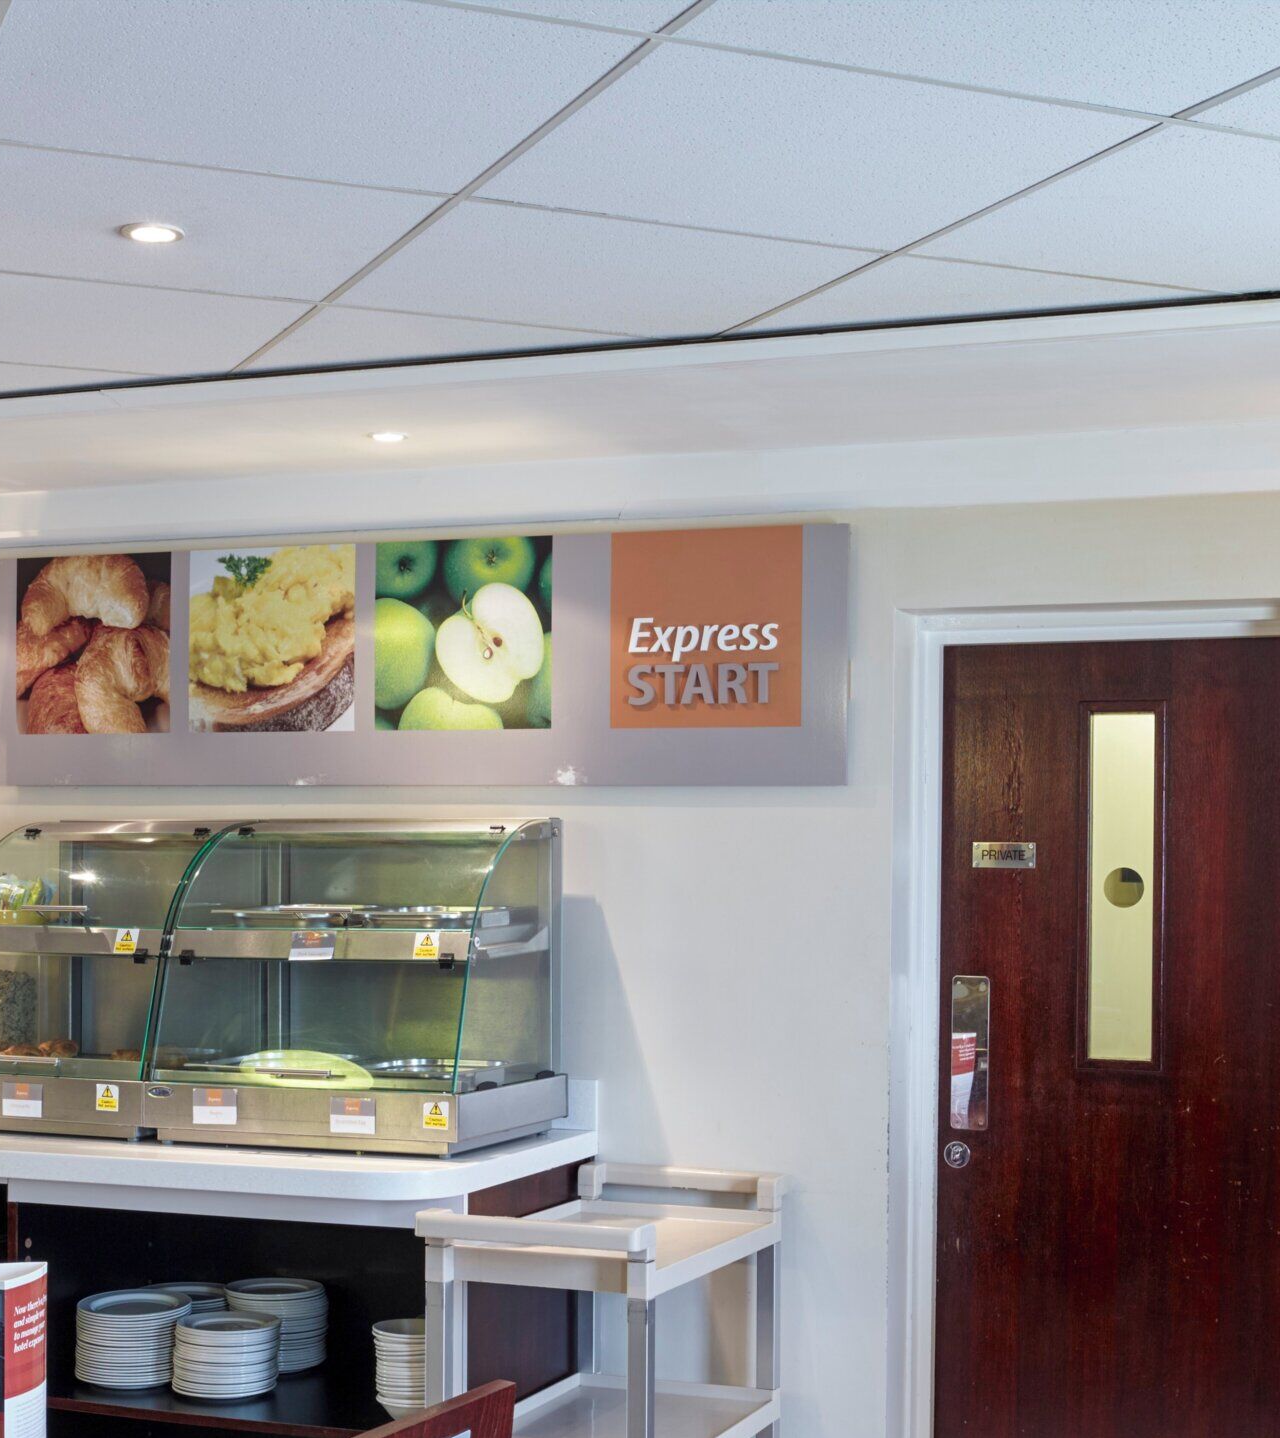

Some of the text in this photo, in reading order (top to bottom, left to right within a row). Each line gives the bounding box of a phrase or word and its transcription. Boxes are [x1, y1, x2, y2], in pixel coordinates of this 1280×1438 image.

[628, 616, 780, 662] Express
[628, 662, 780, 706] START
[981, 849, 1026, 861] PRIVATE
[14, 1316, 25, 1328] and
[14, 1332, 20, 1341] to
[14, 1339, 28, 1354] hotel
